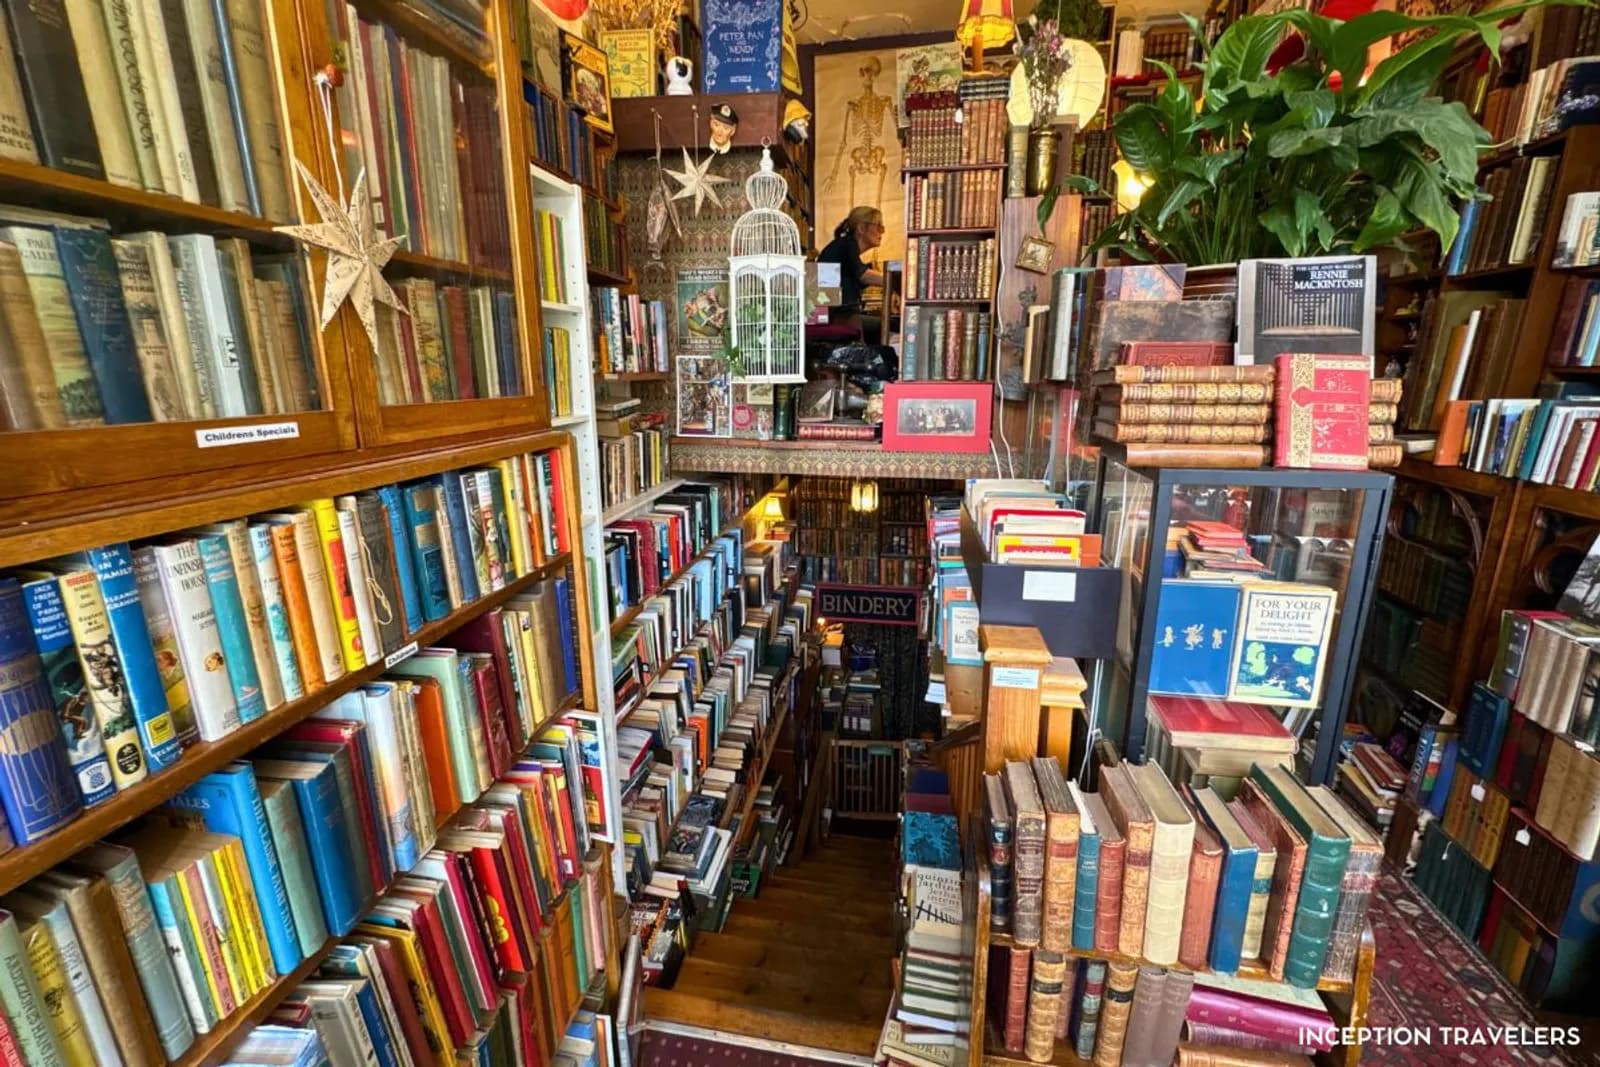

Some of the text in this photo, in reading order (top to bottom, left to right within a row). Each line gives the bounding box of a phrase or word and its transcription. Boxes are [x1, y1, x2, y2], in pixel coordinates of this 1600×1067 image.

[720, 31, 765, 41] PETER PAN
[728, 45, 755, 54] WENDY
[1310, 269, 1348, 280] RENNIE
[1294, 279, 1363, 290] MACKINTOSH
[204, 426, 295, 442] Childrens Specials
[101, 550, 120, 560] SIX
[176, 543, 196, 561] THE
[98, 558, 127, 571] IN A
[822, 594, 912, 617] BINDERY
[1255, 599, 1322, 611] FOR YOUR
[1260, 609, 1312, 621] DELIGHT
